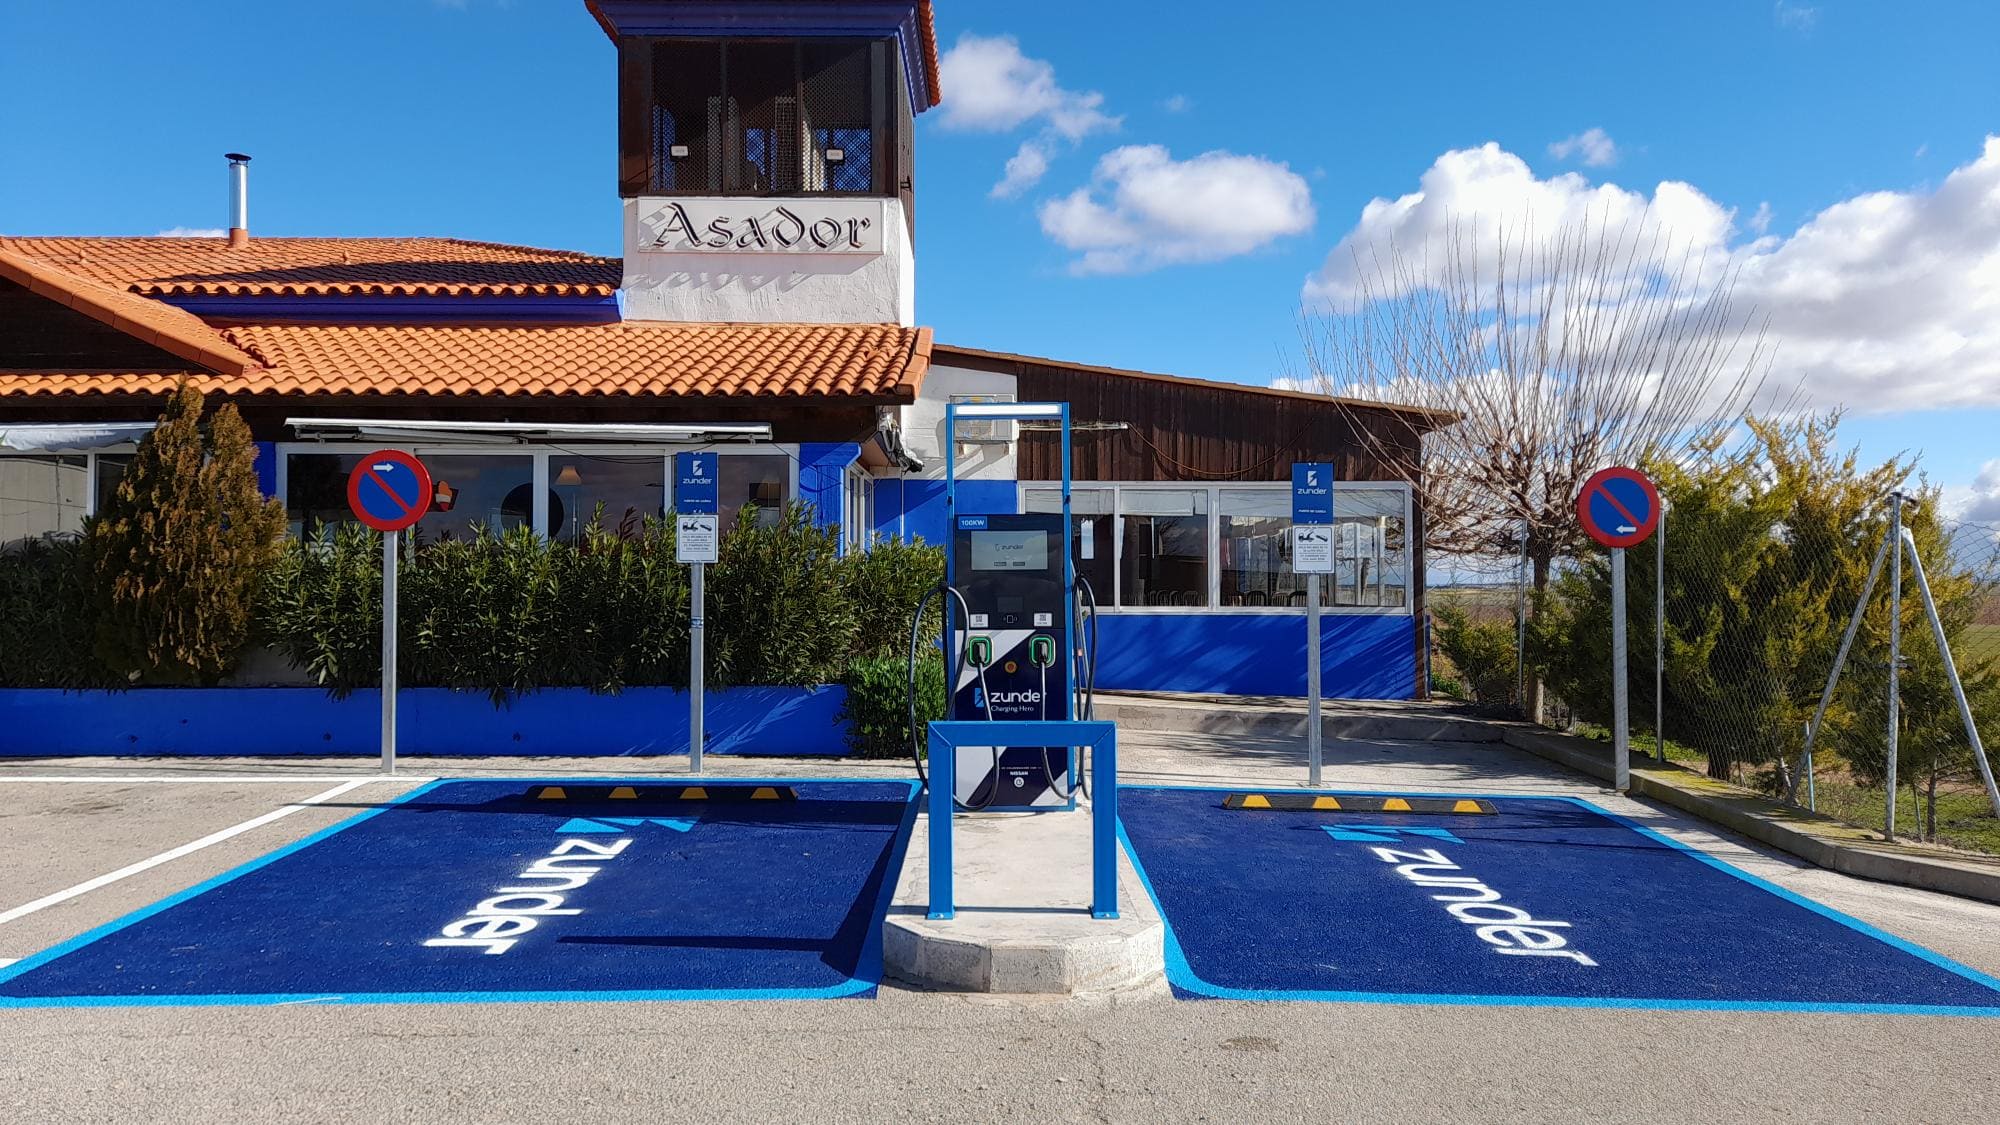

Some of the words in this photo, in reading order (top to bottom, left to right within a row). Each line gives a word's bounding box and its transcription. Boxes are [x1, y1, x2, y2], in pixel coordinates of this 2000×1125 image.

[652, 202, 872, 249] Asador
[682, 477, 712, 485] zunder
[1297, 487, 1327, 495] zunder
[991, 705, 1018, 713] Charging
[422, 838, 634, 956] zunder
[1370, 847, 1600, 967] zunder
